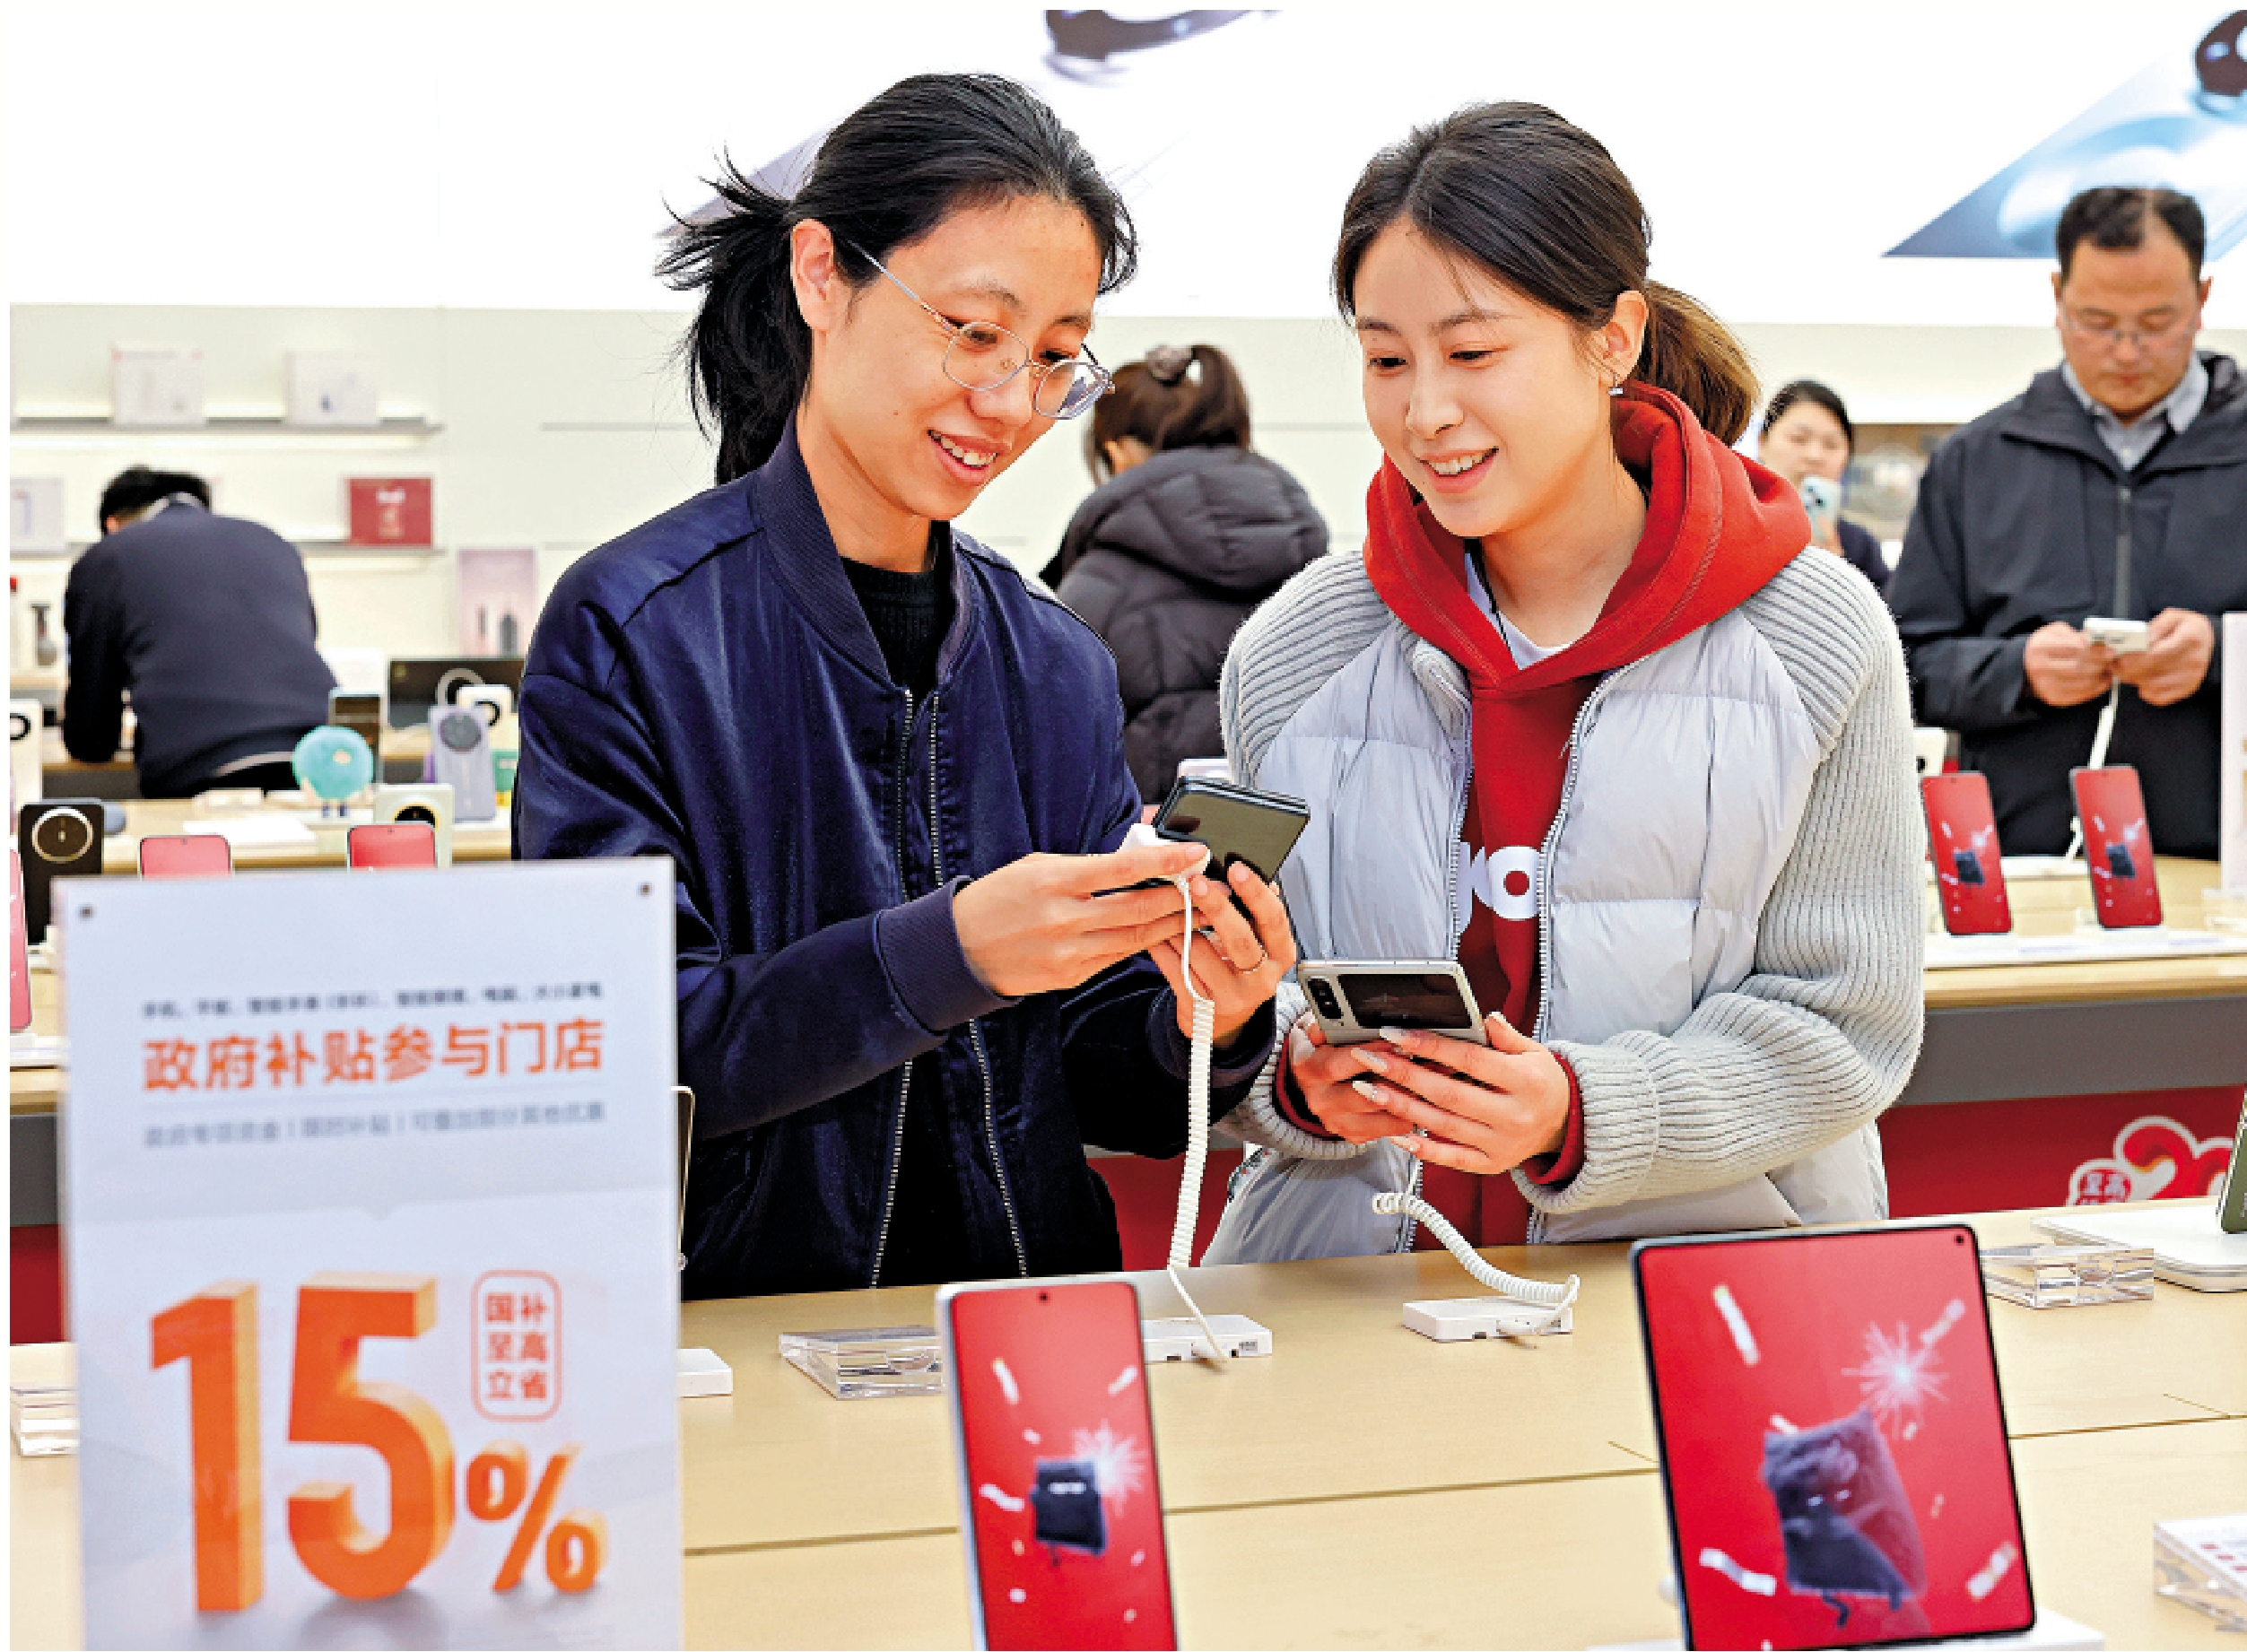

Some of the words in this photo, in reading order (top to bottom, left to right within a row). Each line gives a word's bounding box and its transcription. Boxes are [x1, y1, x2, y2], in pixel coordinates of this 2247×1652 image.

[144, 1017, 604, 1092] 政府补贴参与门店
[483, 1291, 550, 1326] 国补
[484, 1330, 550, 1363] 至高
[485, 1368, 550, 1402] 立省
[150, 1271, 608, 1613] 15%
